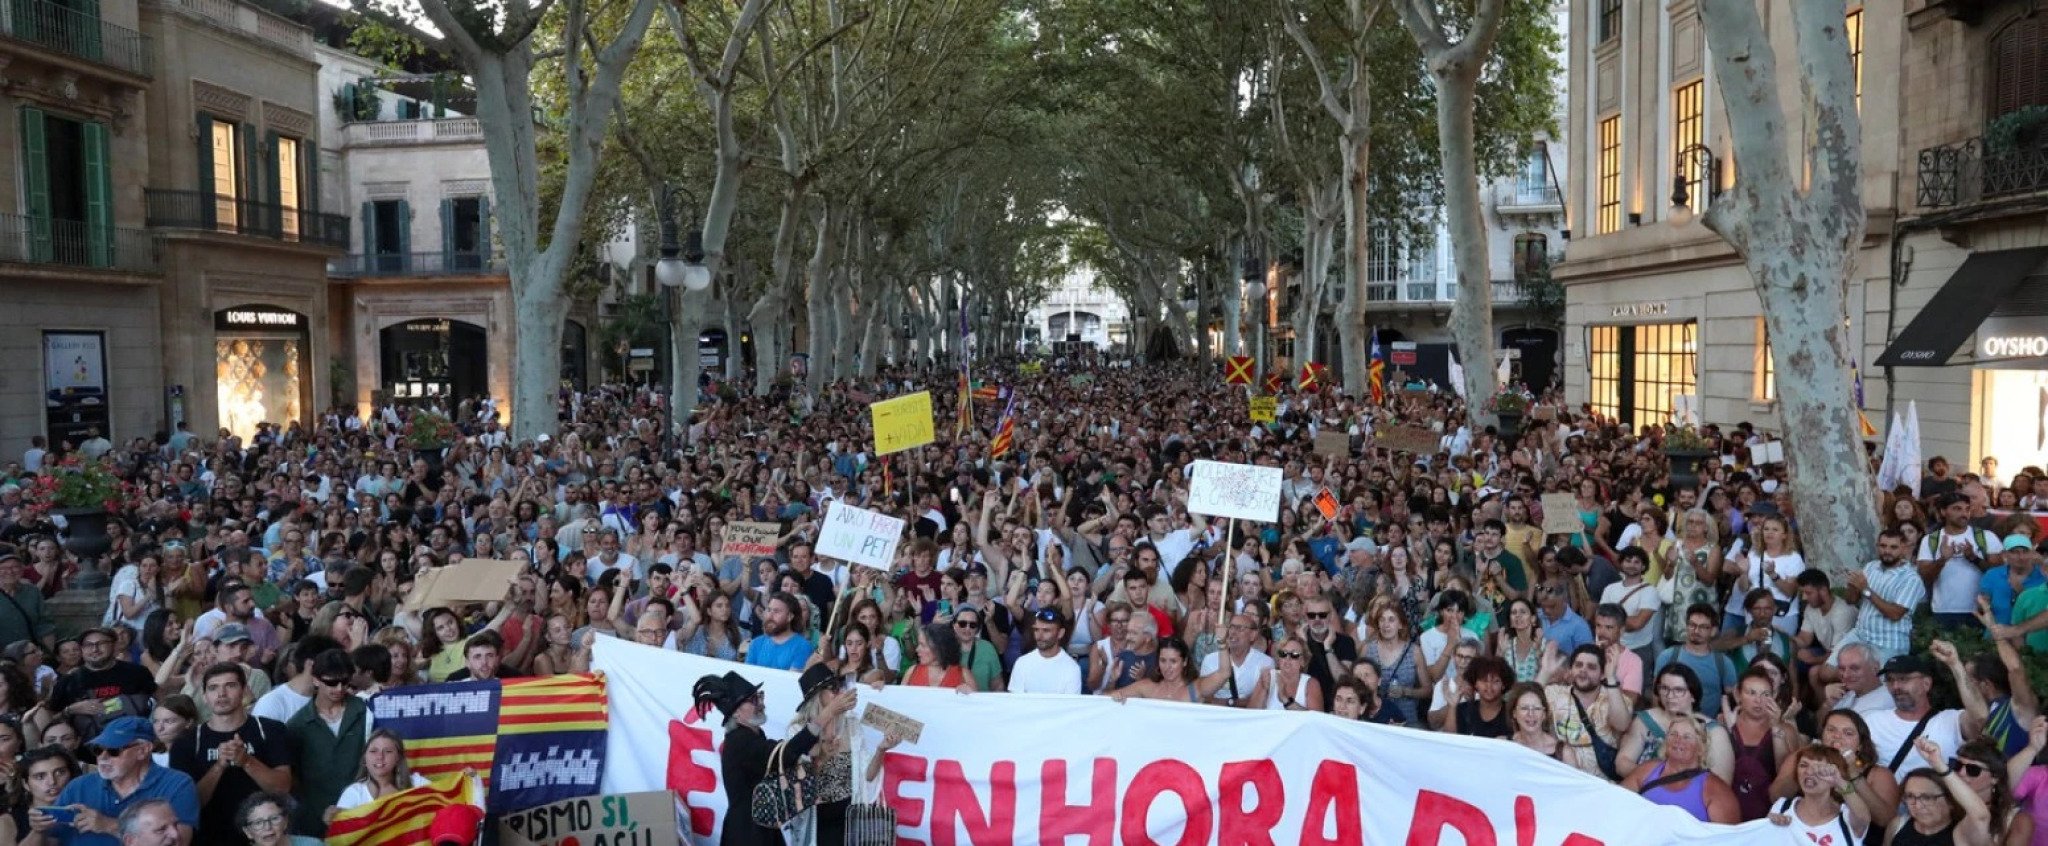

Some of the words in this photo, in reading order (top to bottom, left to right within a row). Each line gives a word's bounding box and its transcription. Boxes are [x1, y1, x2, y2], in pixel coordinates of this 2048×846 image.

[227, 311, 257, 324] LOUIS
[258, 312, 297, 325] VUITTON
[1900, 350, 1936, 359] OYSHO
[1984, 336, 2048, 357] OYSHO
[860, 535, 891, 559] PET
[884, 752, 1016, 846] EN
[1039, 757, 1363, 846] HORA
